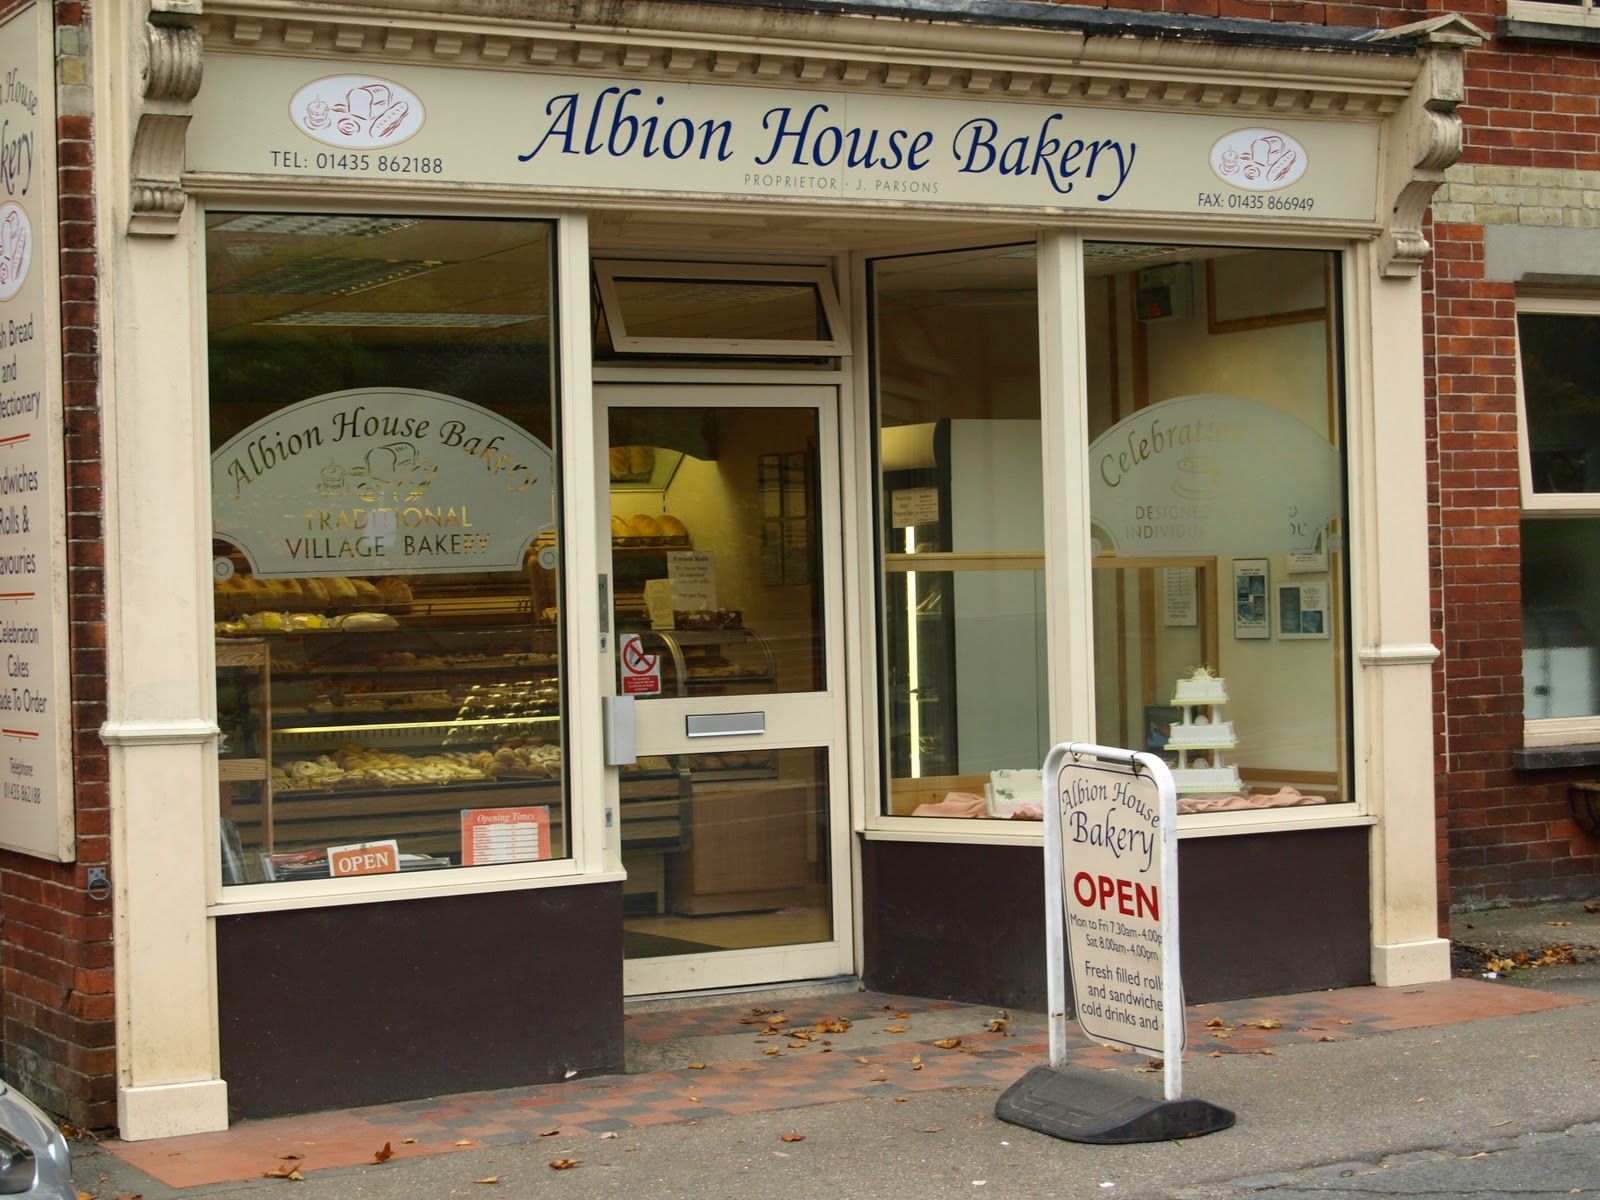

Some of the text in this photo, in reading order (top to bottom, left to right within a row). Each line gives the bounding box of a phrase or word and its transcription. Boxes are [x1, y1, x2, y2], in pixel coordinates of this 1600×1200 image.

[5, 67, 38, 116] House
[518, 87, 1137, 201] Albion House Bakery
[270, 150, 443, 174] TEL: 01435 862188
[744, 173, 837, 190] PROPRIETOR
[856, 180, 868, 192] J.
[874, 179, 939, 194] PARSONS
[1198, 193, 1314, 212] FAX: 01435 866949
[9, 312, 33, 346] Bread
[2, 354, 17, 382] and
[227, 406, 539, 500] Albion House Bakery
[22, 505, 30, 533] &
[304, 506, 473, 531] TRADITIONAL
[285, 533, 490, 559] VILLAGE BAKERY
[8, 654, 29, 678] Cakes
[12, 688, 21, 711] To
[23, 688, 47, 713] Order
[10, 757, 33, 780] Telephone
[4, 782, 41, 804] 01435 862188
[1062, 778, 1160, 828] Albion House
[477, 812, 535, 824] Opening Times
[1069, 808, 1155, 873] Bakery
[338, 851, 389, 873] OPEN
[1073, 871, 1160, 922] OPEN
[1070, 913, 1087, 928] Mon
[1088, 918, 1097, 930] to
[1098, 918, 1109, 933] Fri
[1086, 934, 1098, 948] Sat
[1085, 960, 1163, 991] Fresh filled roll
[1088, 984, 1163, 1012] and sandwiche
[1081, 1002, 1102, 1018] cold
[1105, 1007, 1136, 1026] drinks
[1140, 1015, 1159, 1031] and
